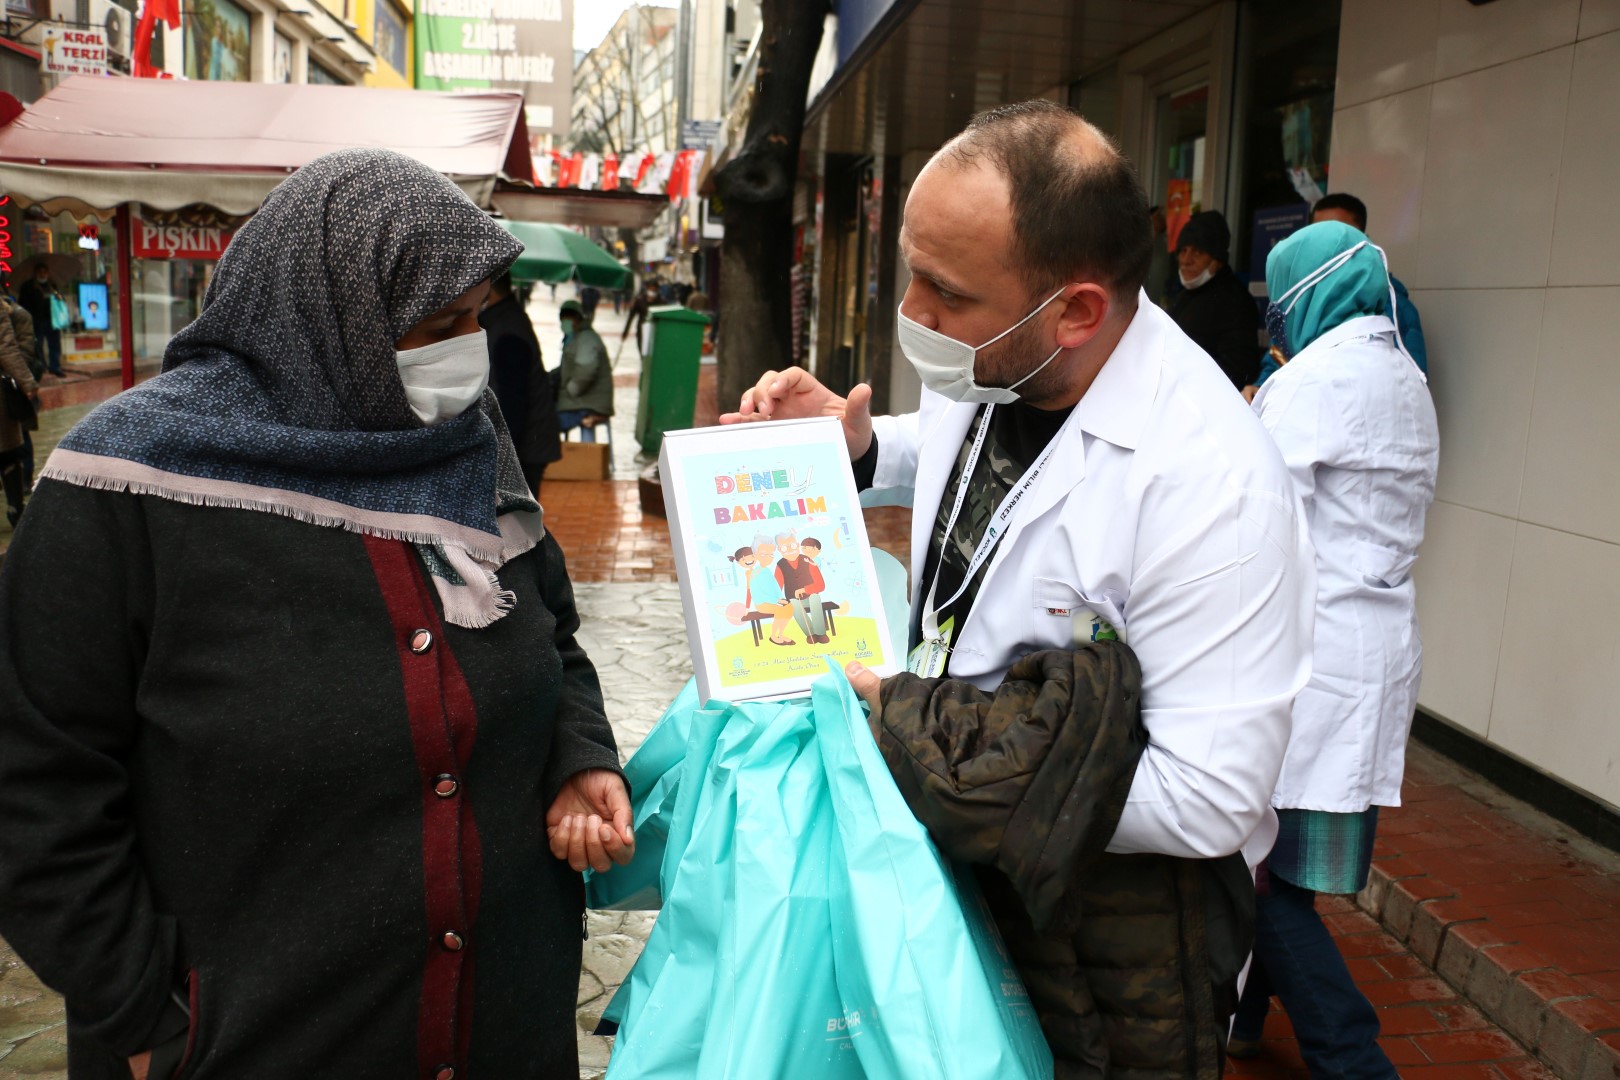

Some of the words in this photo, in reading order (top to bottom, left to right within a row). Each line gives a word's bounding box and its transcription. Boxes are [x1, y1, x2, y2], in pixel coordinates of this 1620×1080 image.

[63, 31, 104, 46] KRAL
[142, 219, 221, 257] PİŞKİN
[714, 465, 815, 496] DENEY
[713, 495, 828, 525] BAKALIM
[1000, 489, 1024, 522] MERKEZİ
